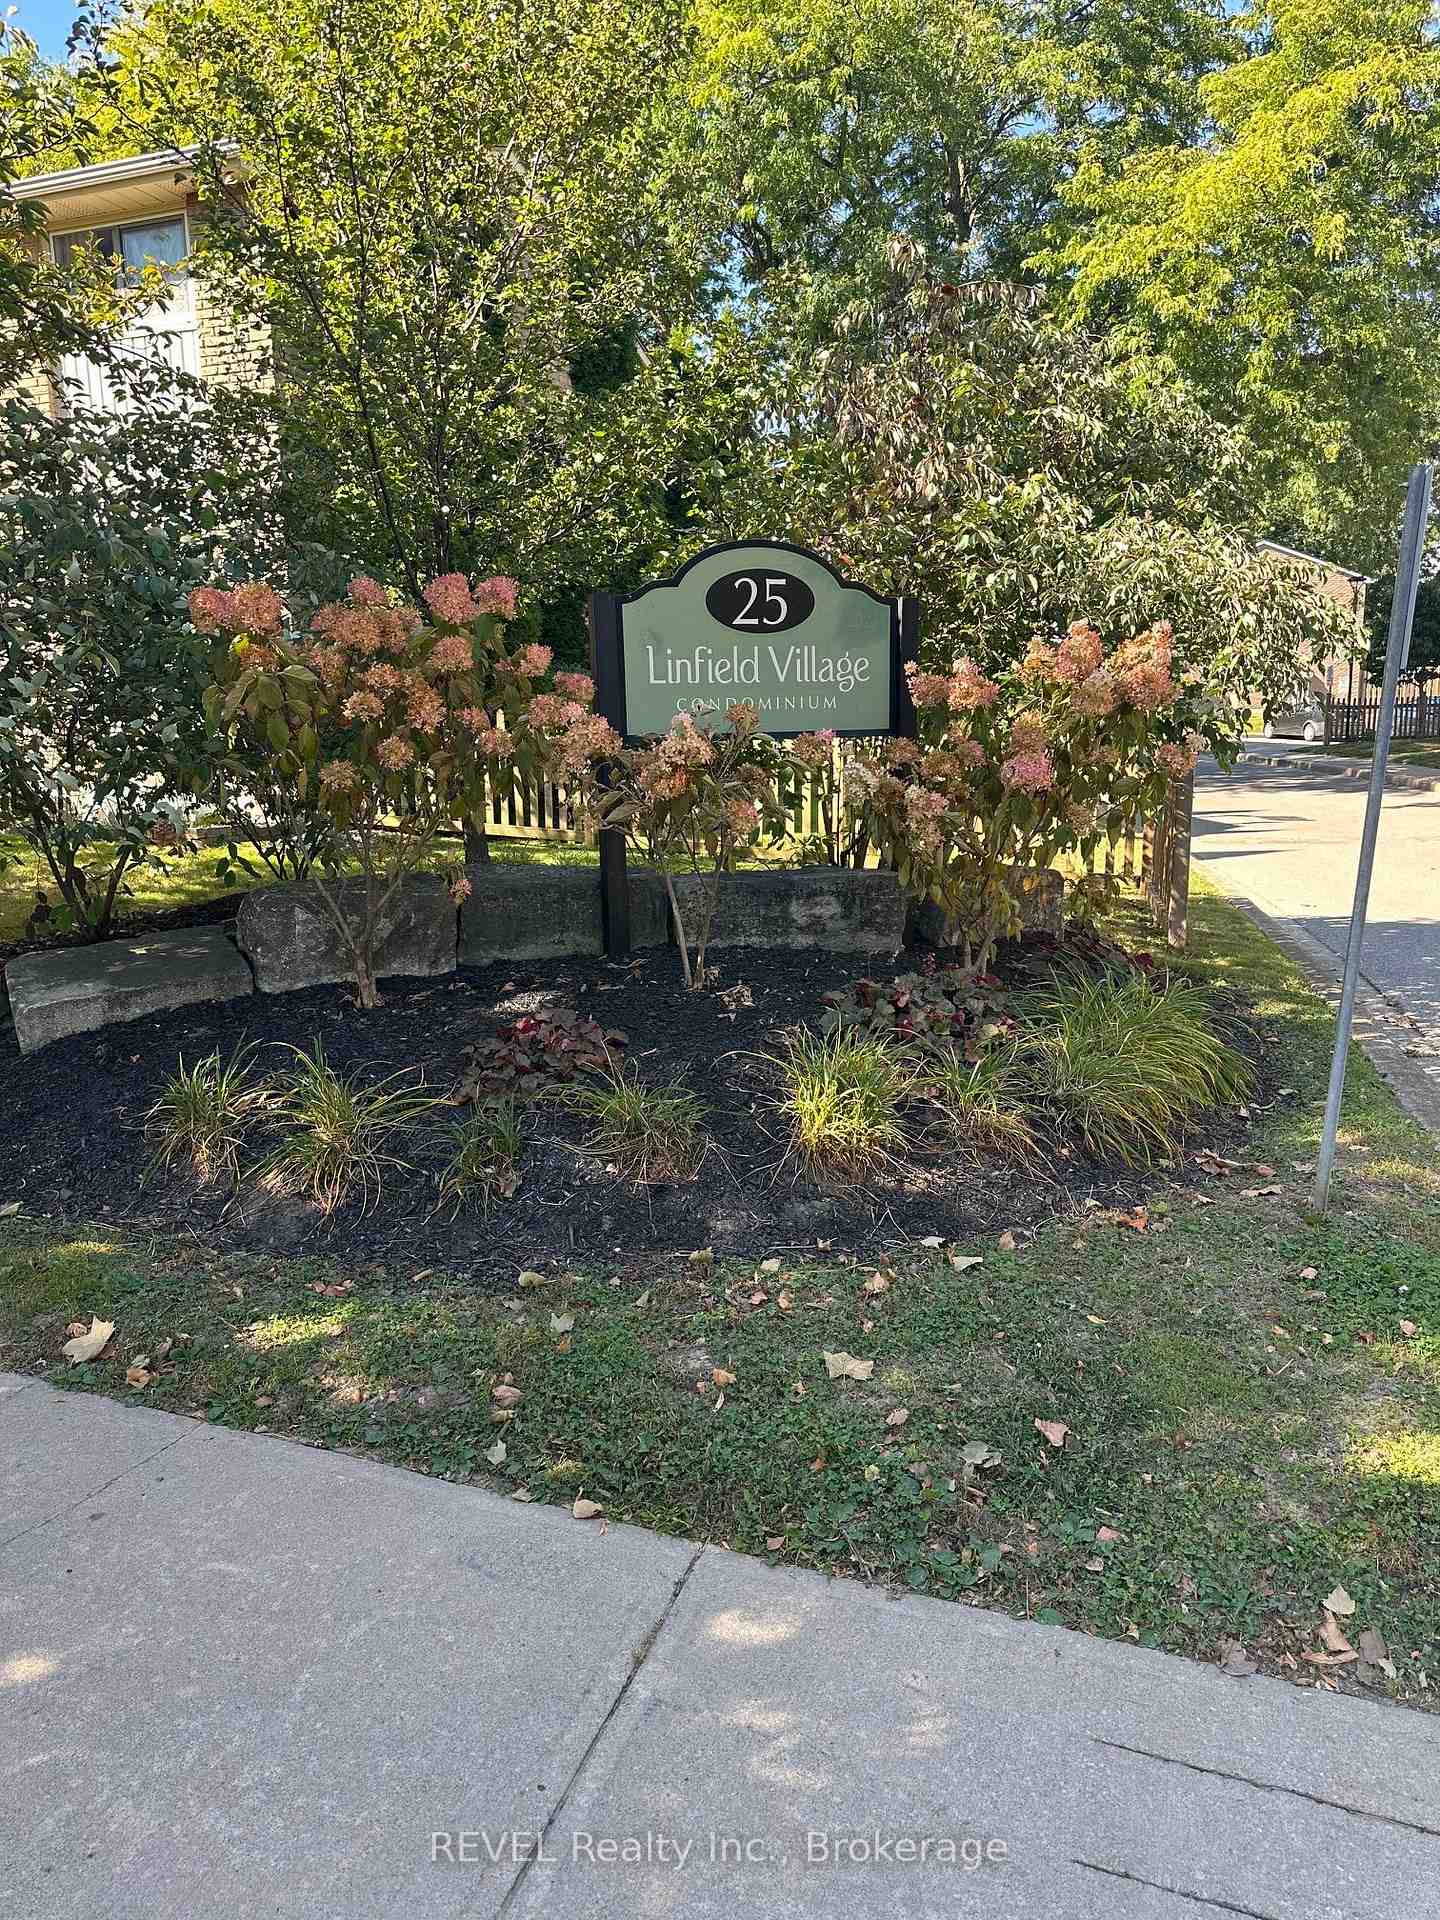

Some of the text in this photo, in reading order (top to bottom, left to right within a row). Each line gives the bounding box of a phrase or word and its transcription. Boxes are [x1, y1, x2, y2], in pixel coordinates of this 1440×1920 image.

[732, 577, 788, 625] 25
[646, 645, 870, 692] Linfield Village
